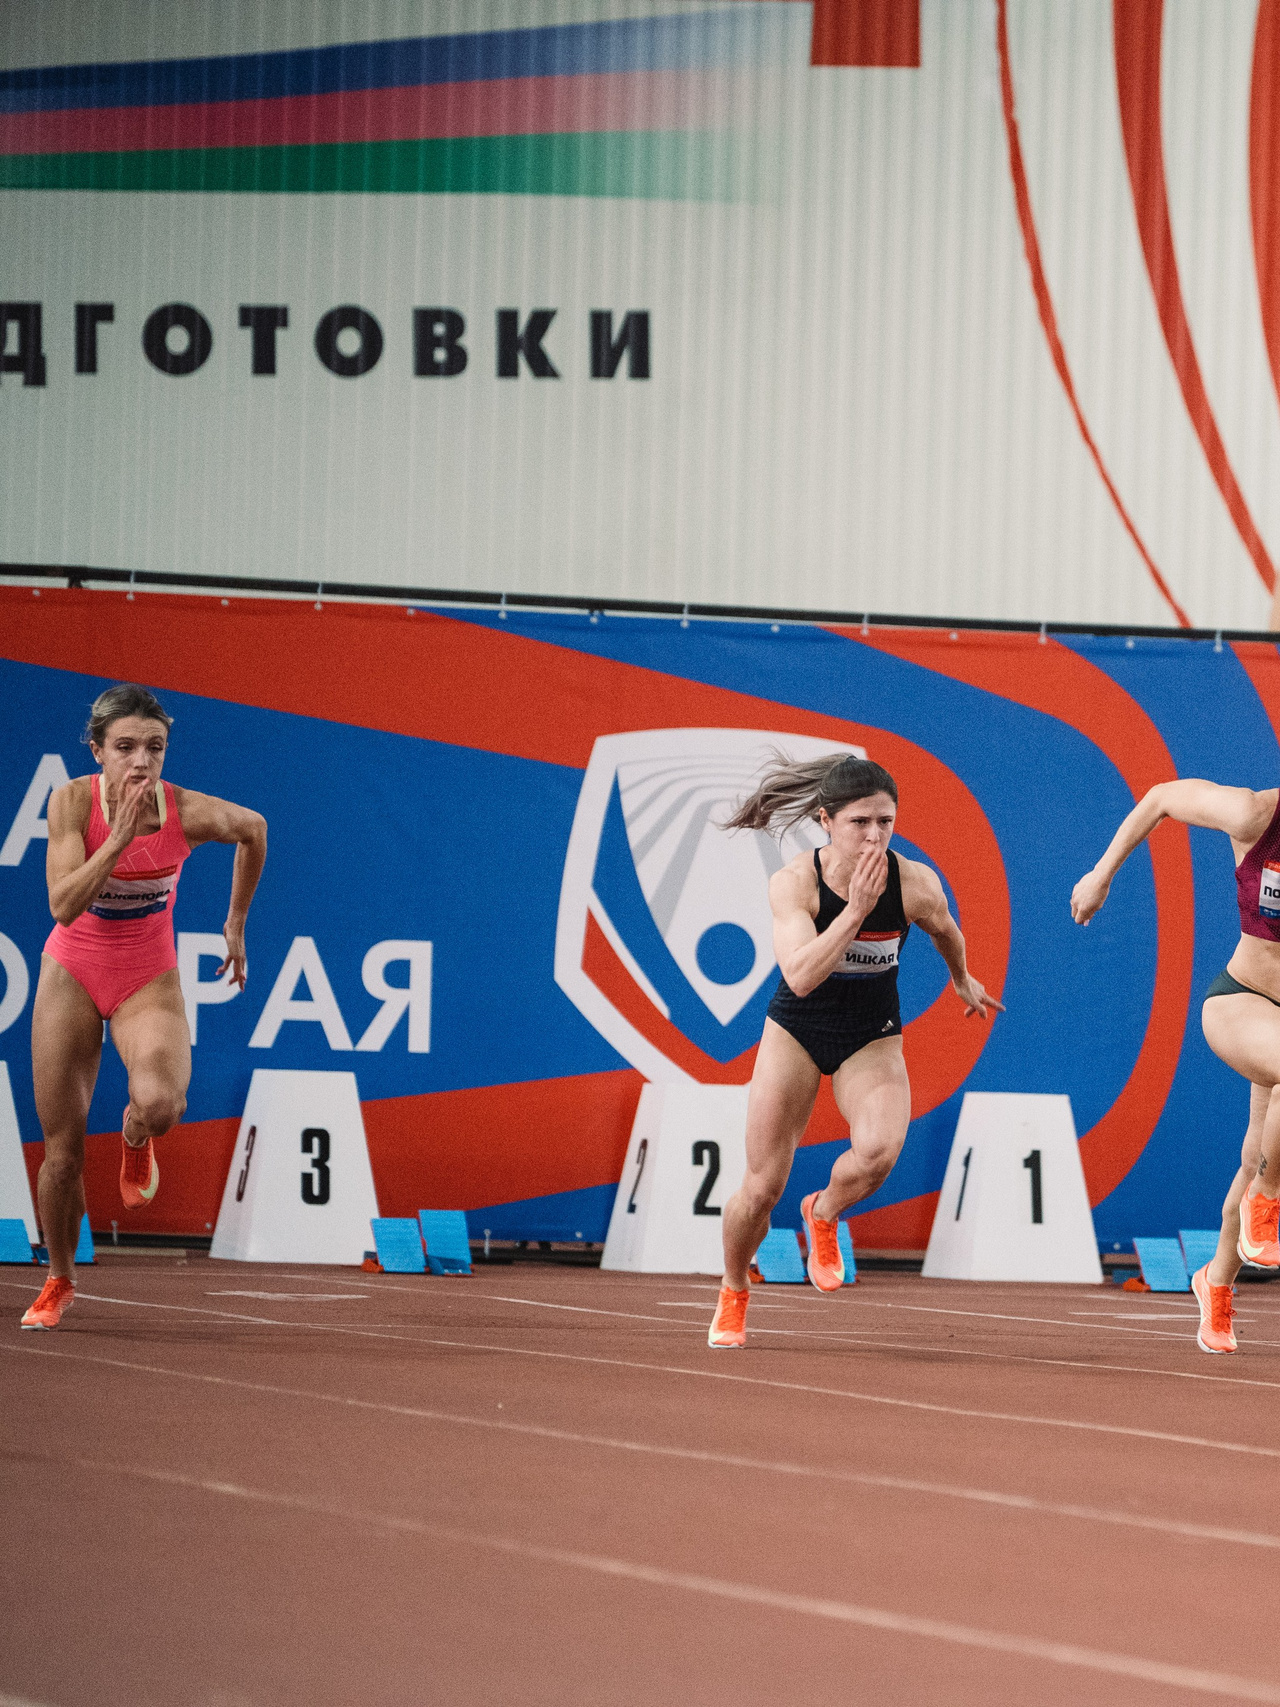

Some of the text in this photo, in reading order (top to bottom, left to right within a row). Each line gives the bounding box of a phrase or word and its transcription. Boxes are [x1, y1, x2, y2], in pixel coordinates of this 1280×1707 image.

[103, 931, 433, 1054] РАЯ
[300, 1127, 331, 1205] 3
[691, 1140, 722, 1217] 2
[1022, 1149, 1044, 1225] 1
